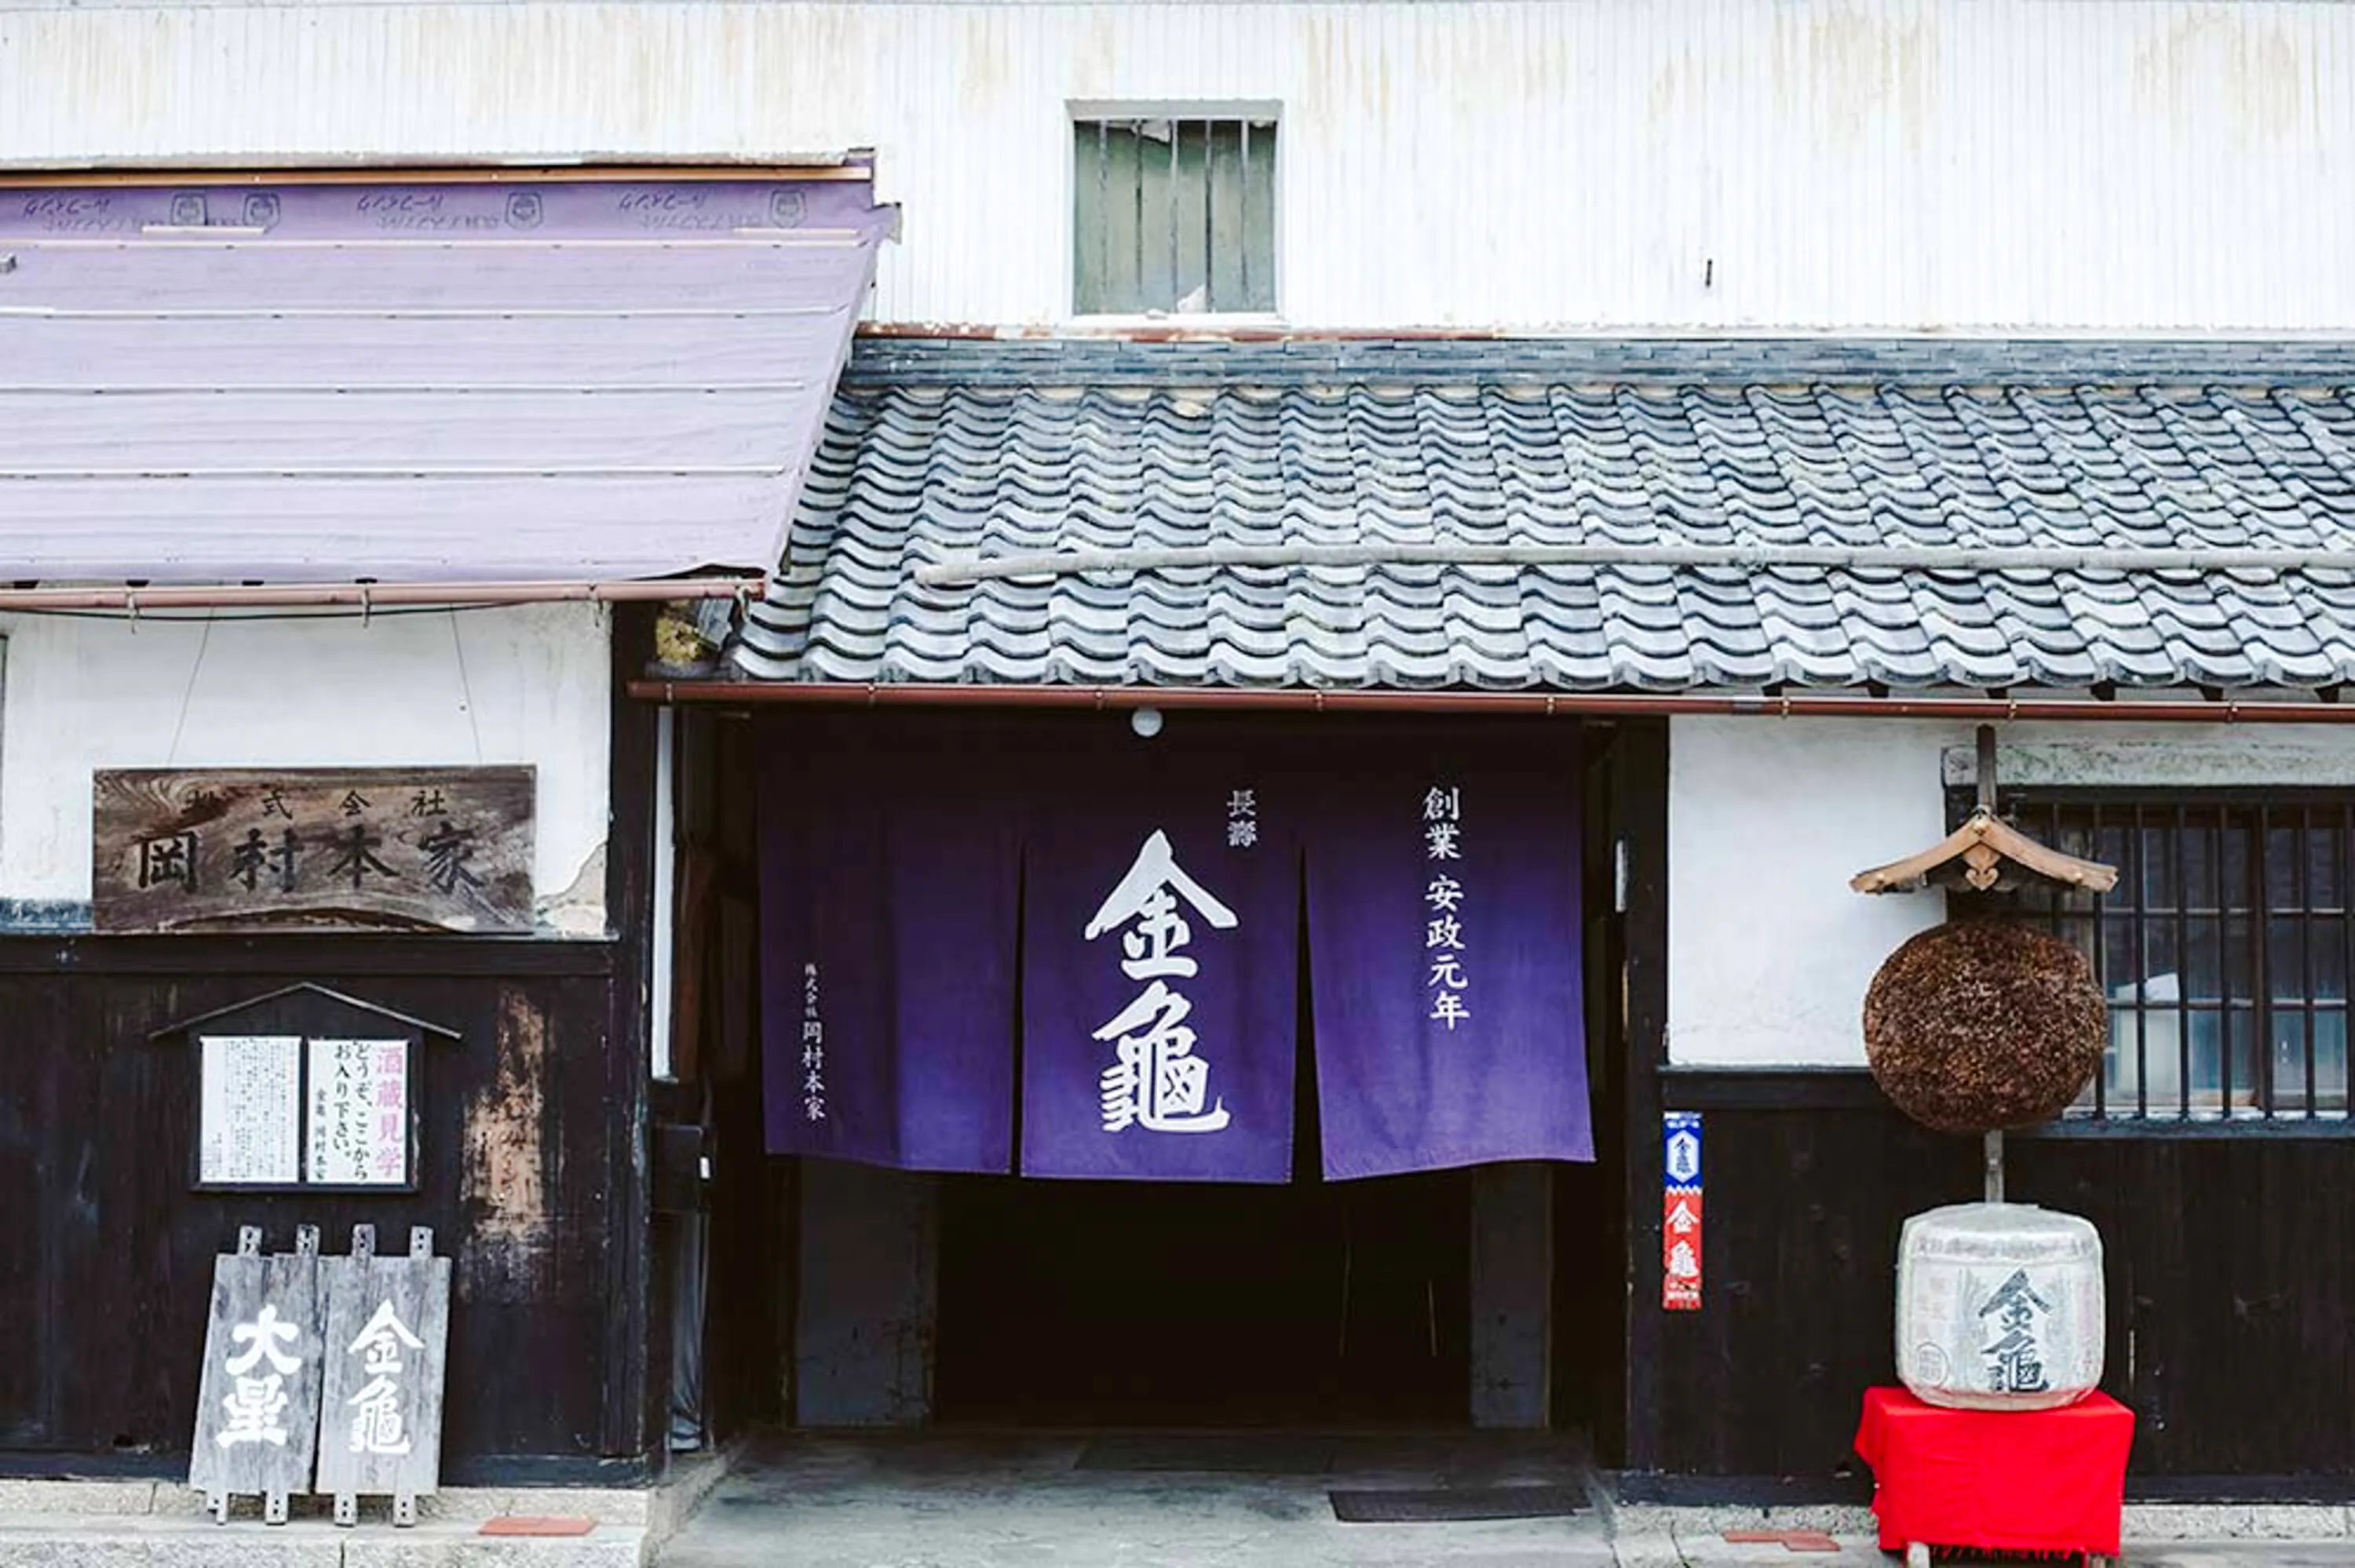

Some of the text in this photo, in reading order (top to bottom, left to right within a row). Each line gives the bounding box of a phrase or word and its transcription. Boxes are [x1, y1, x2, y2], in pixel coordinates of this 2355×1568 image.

[133, 820, 489, 894] 岡村本家
[1422, 786, 1470, 1031] 創業 安政元年
[376, 1047, 403, 1177] 酒蔵見学
